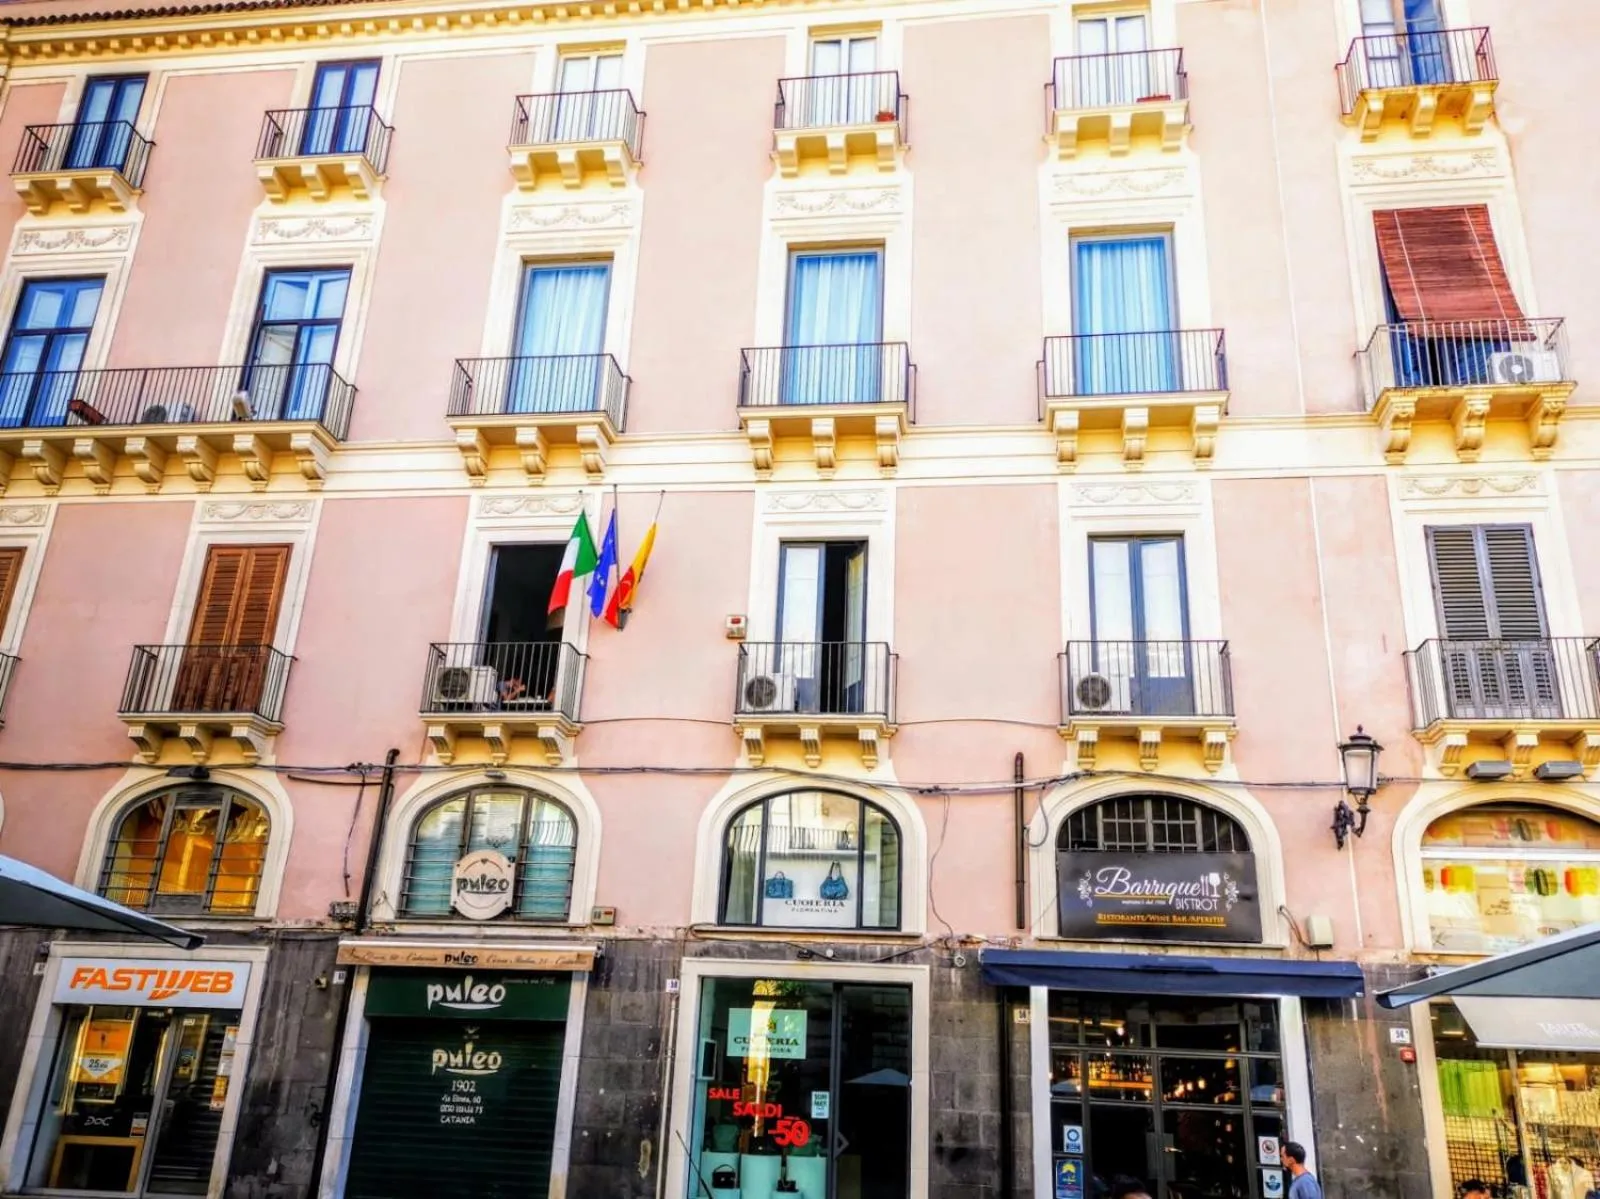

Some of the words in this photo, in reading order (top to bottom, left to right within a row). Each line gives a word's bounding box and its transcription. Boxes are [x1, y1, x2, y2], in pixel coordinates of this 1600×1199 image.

[456, 872, 510, 894] puleo
[1094, 866, 1201, 905] Barrique
[1175, 898, 1218, 911] BISTROT
[444, 950, 479, 965] puleo
[70, 966, 234, 999] FASTWEB
[427, 975, 506, 1010] puleo
[734, 1036, 799, 1046] CUERIA
[432, 1041, 502, 1075] puleo
[451, 1080, 476, 1093] 1902
[709, 1088, 740, 1100] SALE
[733, 1103, 782, 1118] SALDI
[440, 1115, 476, 1124] CATANIA
